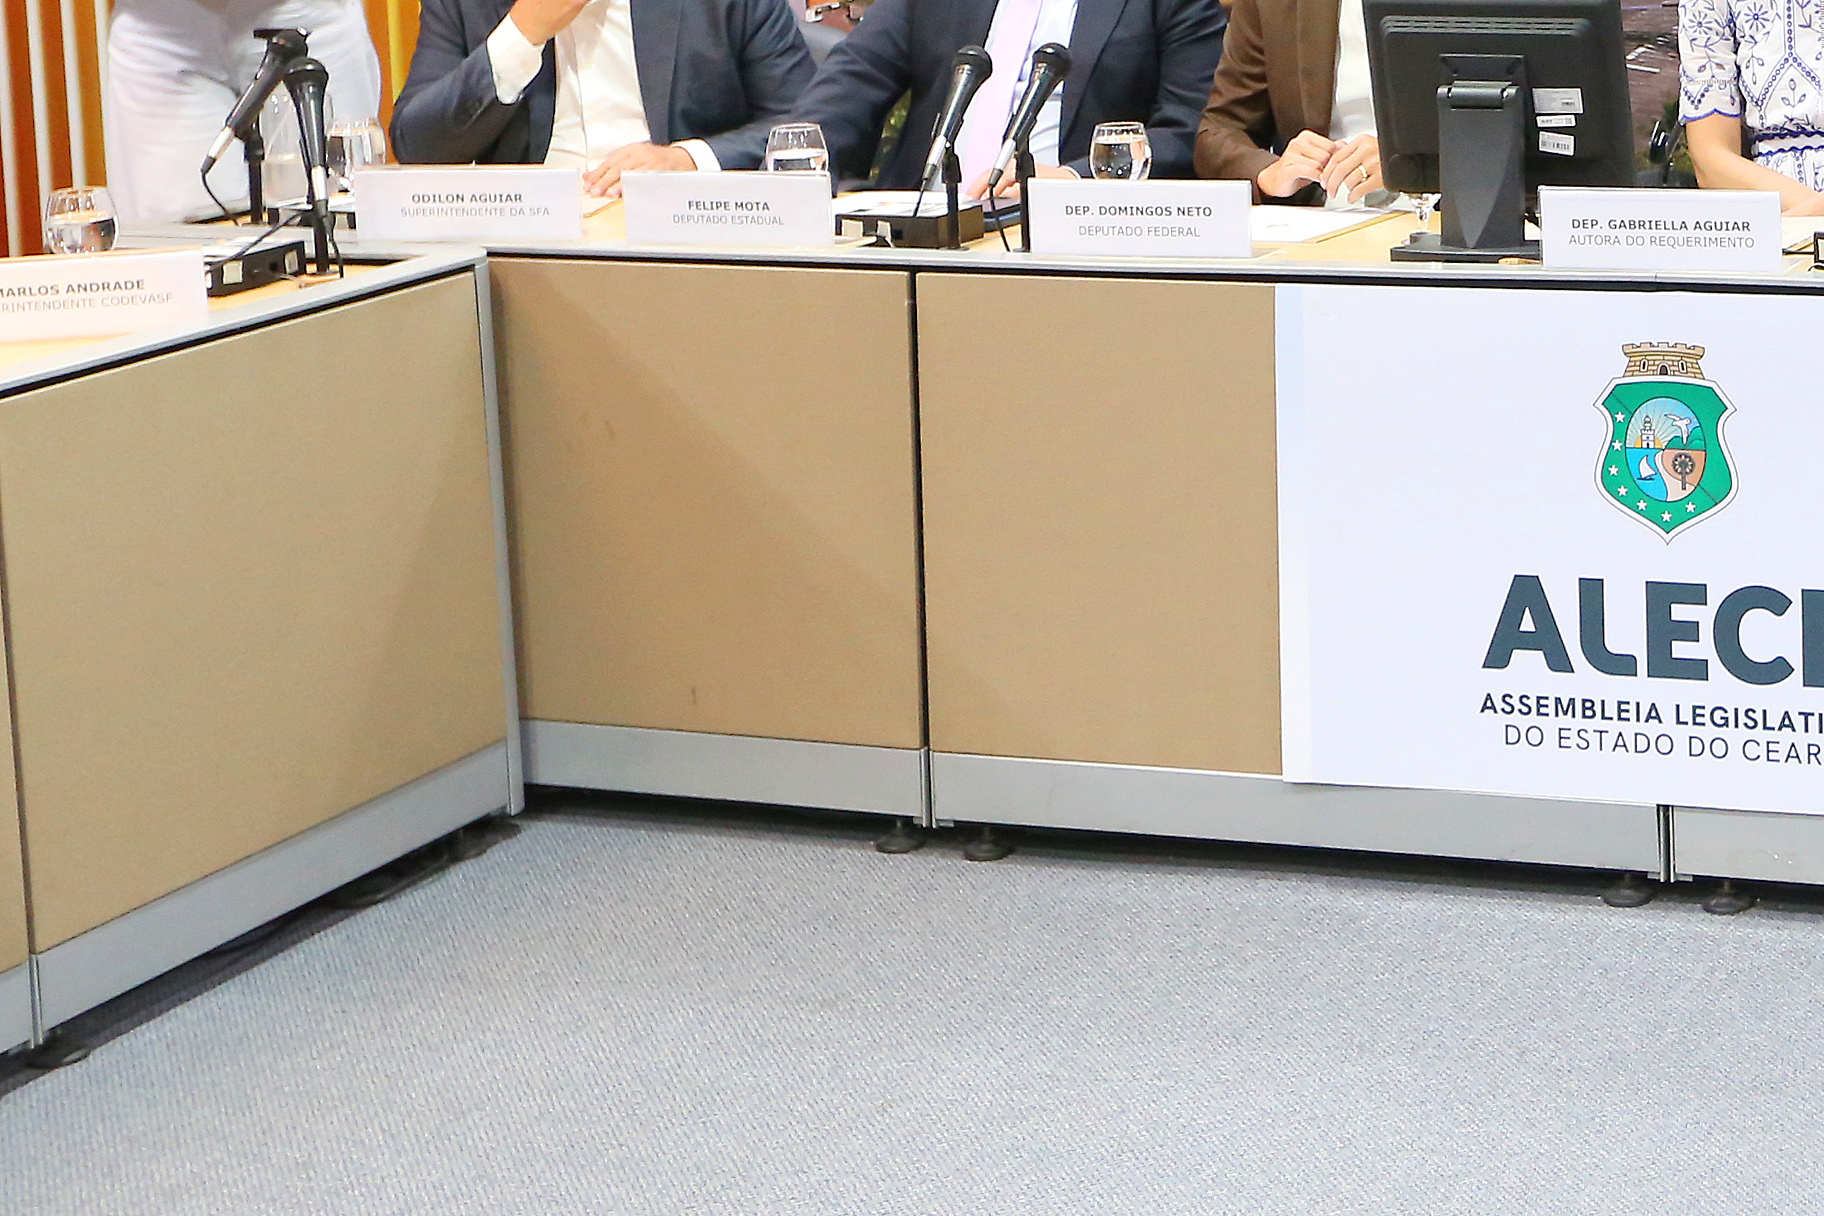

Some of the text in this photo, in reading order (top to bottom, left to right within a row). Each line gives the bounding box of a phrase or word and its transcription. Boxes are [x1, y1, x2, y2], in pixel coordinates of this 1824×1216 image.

[411, 193, 523, 204] ODILON AGUIAR
[400, 206, 550, 218] SUPERINTENDENTE DA SFA
[688, 200, 770, 212] FELIPE MOTA
[1065, 205, 1213, 217] DEP. DOMINGOS NETO
[672, 214, 785, 226] DEPUTADO ESTADUAL
[1571, 218, 1752, 232] DEP. GABRIELLA AGUIAR
[1078, 225, 1201, 238] DEPUTADO FEDERAL
[1568, 234, 1756, 250] AUTORA DO REQUERIMENTO
[65, 279, 145, 295] ANDRADE
[1480, 692, 1663, 725] ASSEMBLEIA
[1504, 724, 1545, 748] DO
[1558, 727, 1675, 756] ESTADO
[1688, 735, 1730, 760] DO
